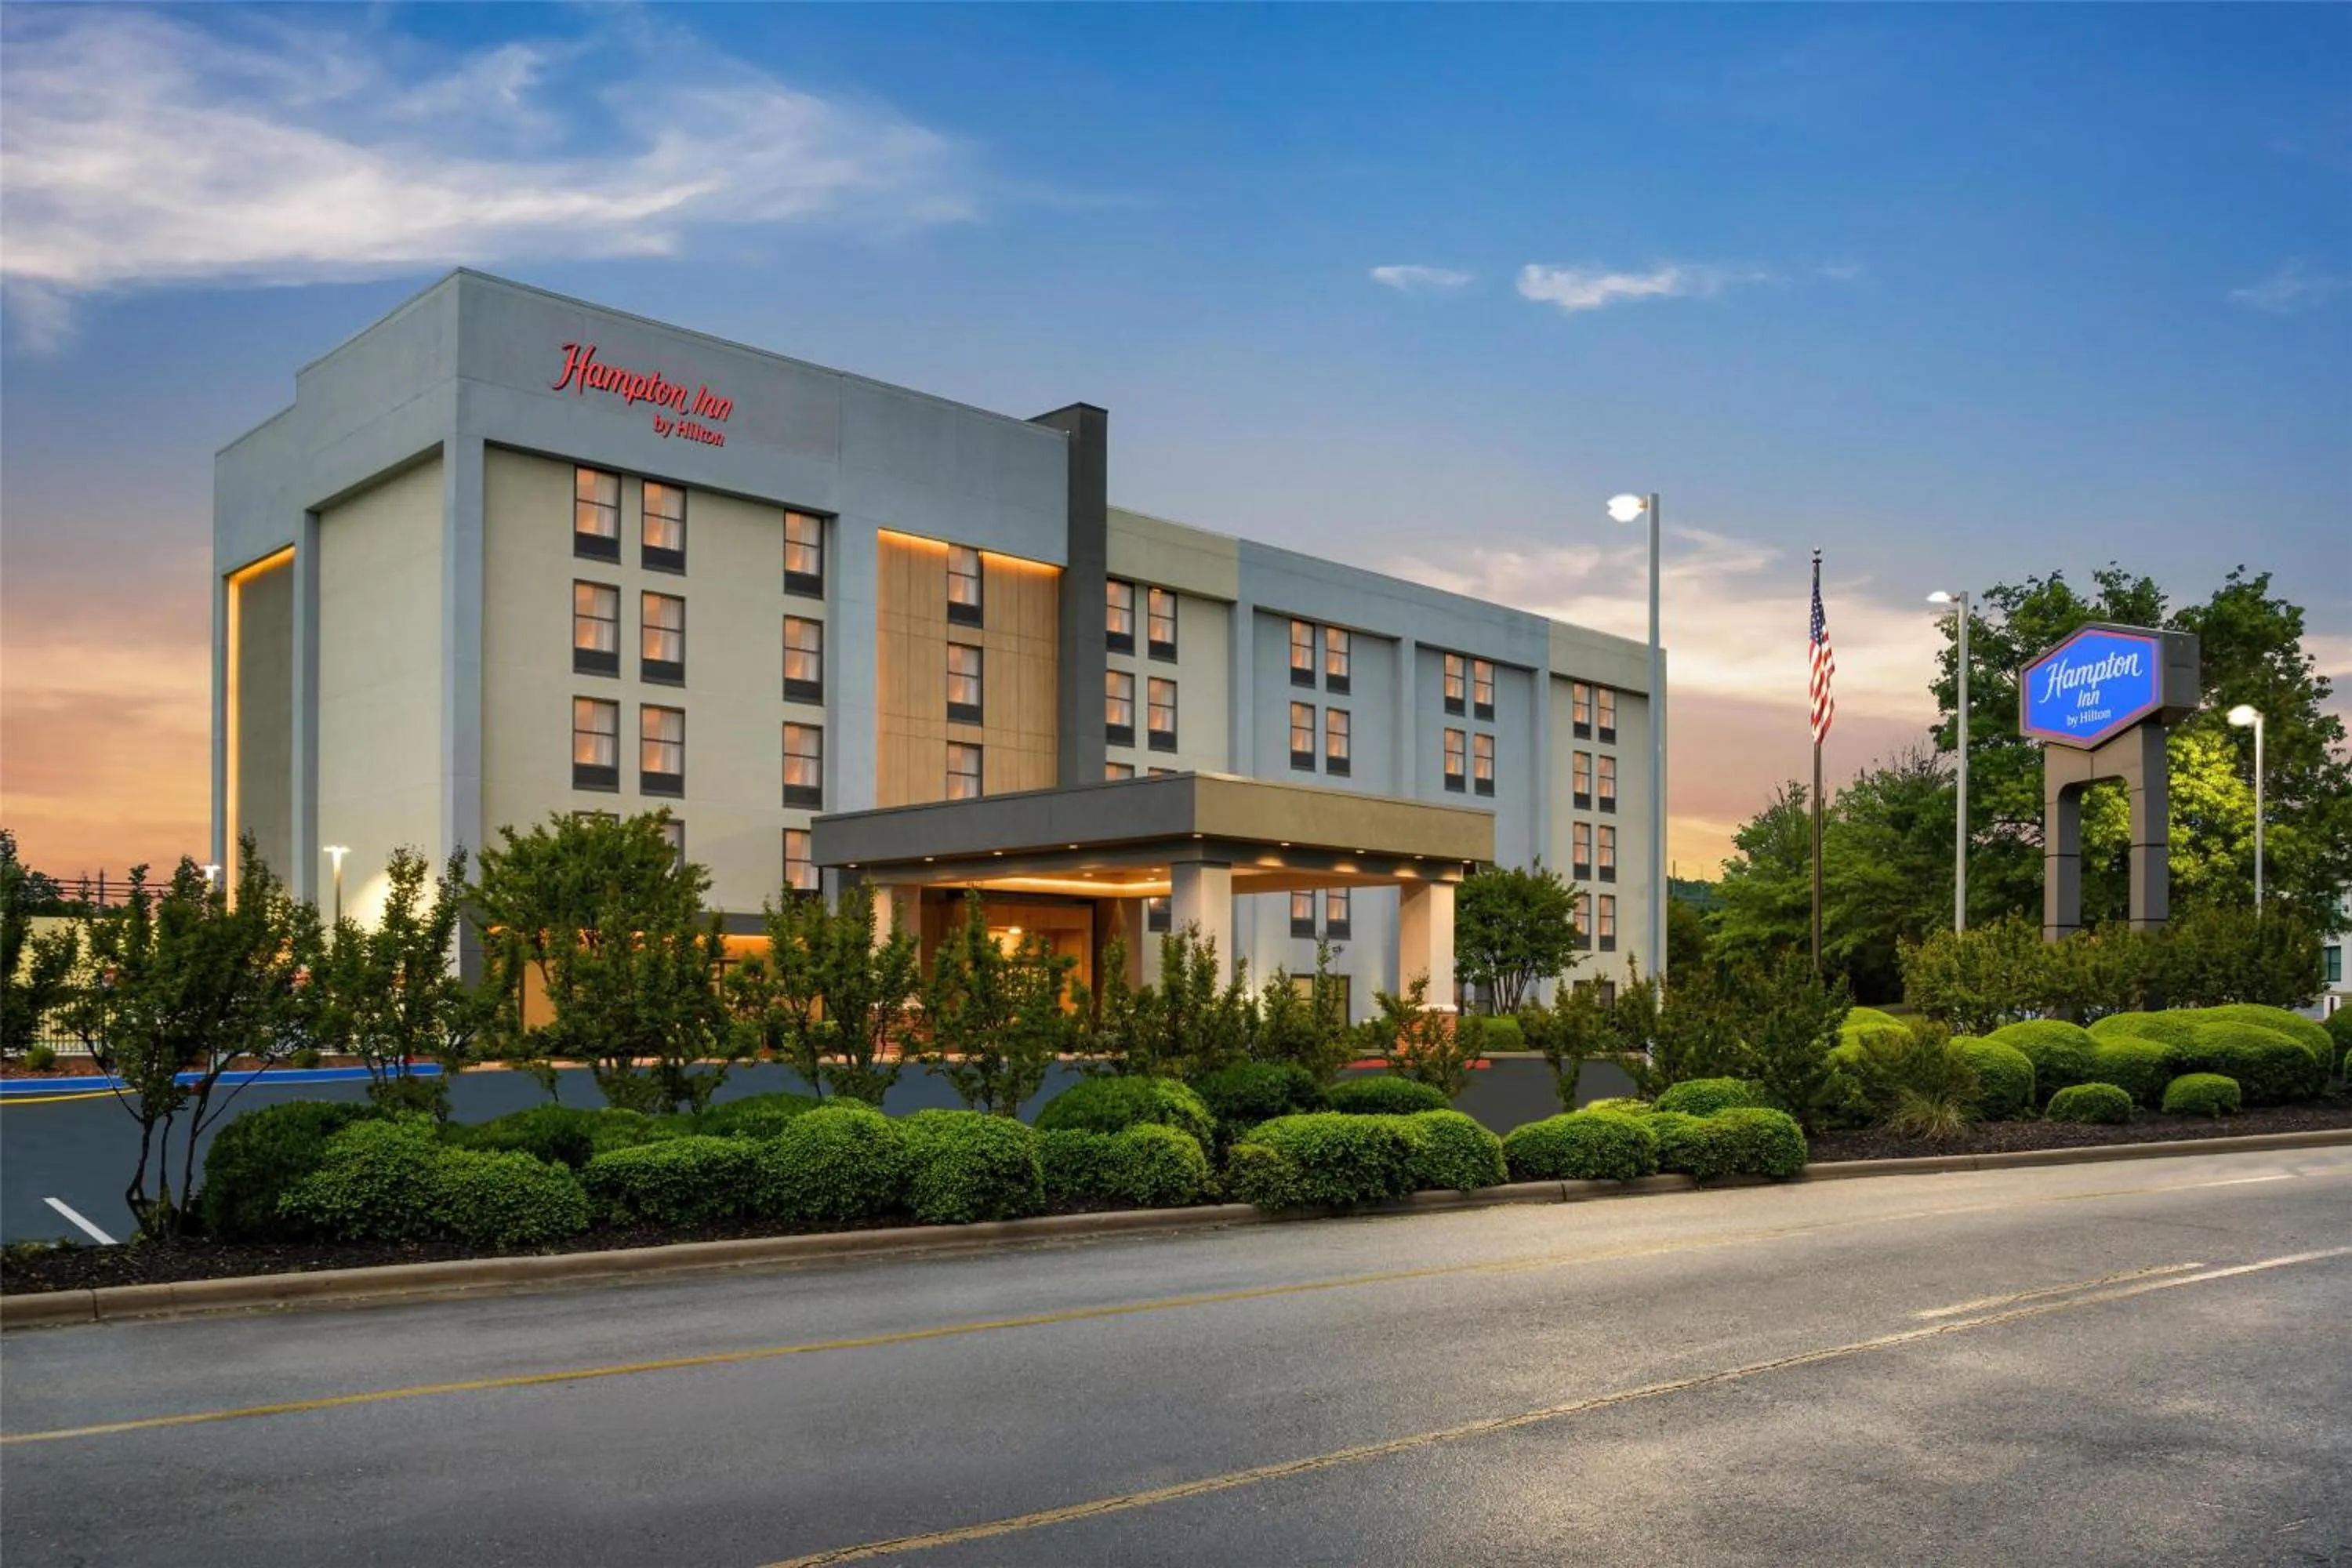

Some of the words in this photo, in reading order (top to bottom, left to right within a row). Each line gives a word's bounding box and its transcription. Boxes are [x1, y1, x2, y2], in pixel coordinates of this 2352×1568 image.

[551, 342, 688, 415] Hampton
[692, 384, 734, 422] Inn
[652, 413, 675, 438] by
[676, 419, 726, 448] Hilton
[2038, 652, 2143, 703] Hampton
[2077, 689, 2100, 709] Inn
[2066, 714, 2078, 728] by
[2080, 709, 2111, 724] Hilton
